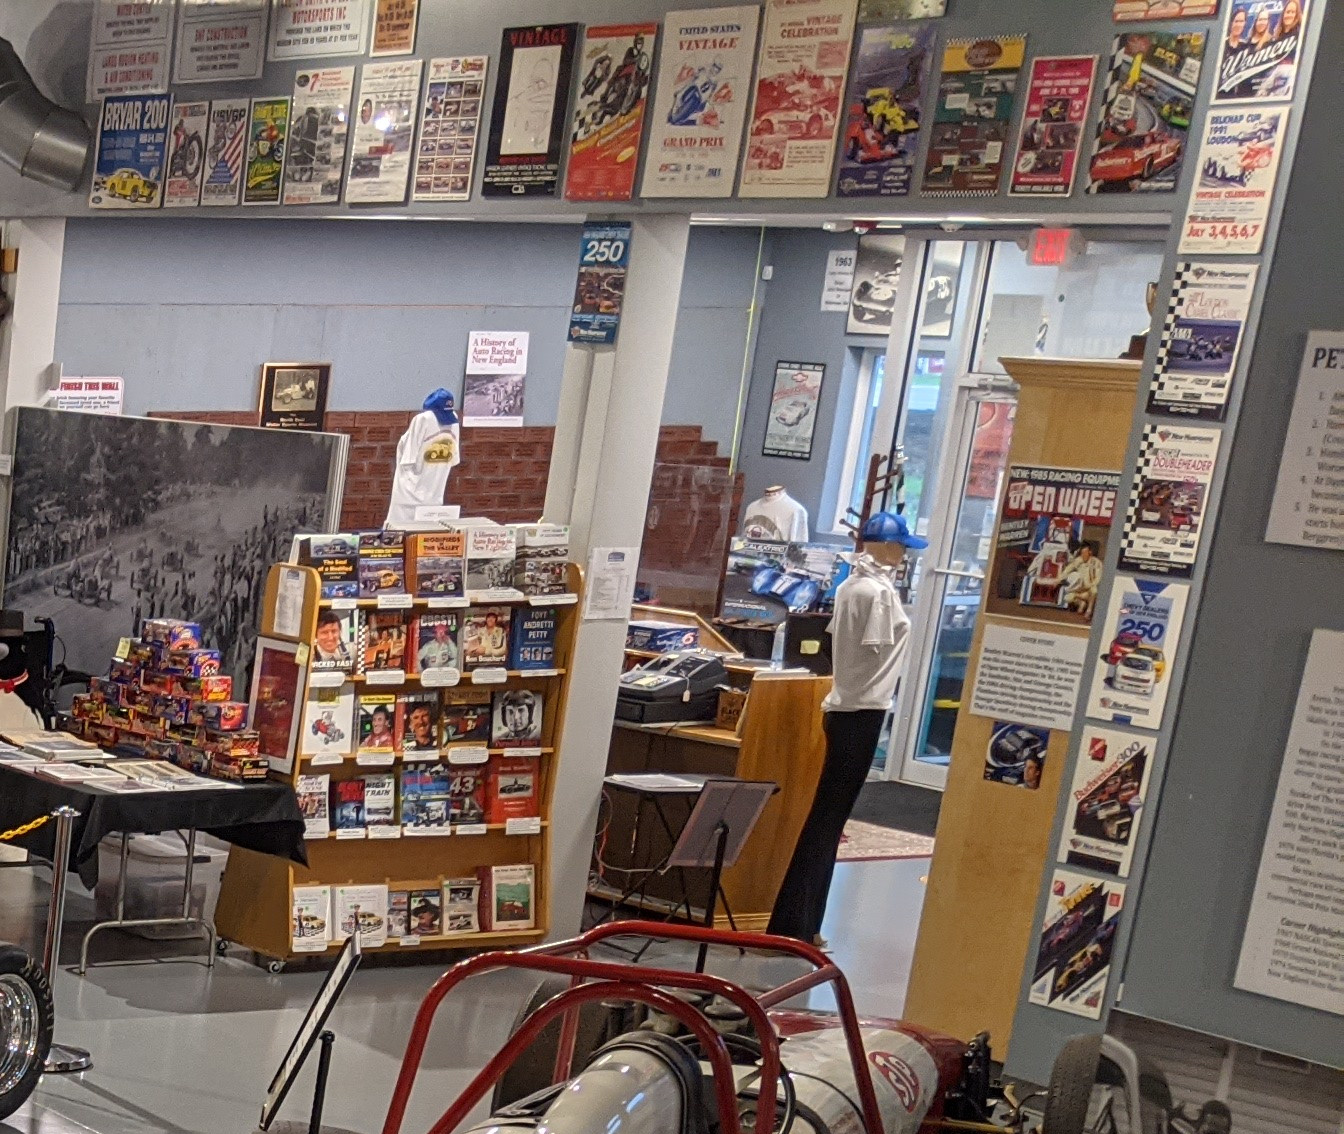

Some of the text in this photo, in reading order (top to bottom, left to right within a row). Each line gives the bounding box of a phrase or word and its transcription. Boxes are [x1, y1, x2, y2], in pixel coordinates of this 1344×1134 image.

[679, 38, 740, 50] VINTAGE
[1221, 35, 1296, 80] Women
[104, 102, 142, 131] BRYAR
[664, 136, 725, 148] GRAND PRIX
[584, 241, 623, 262] 250
[481, 338, 506, 347] History
[508, 338, 516, 346] of
[473, 347, 489, 355] Auto
[491, 348, 514, 357] Racing
[489, 356, 517, 366] England
[1153, 458, 1212, 472] DOUBLEHEADER
[1030, 470, 1120, 486] 1985 RACING EQUIPME
[1058, 491, 1116, 518] WHEE
[523, 620, 554, 630] ANDRETTI
[1119, 618, 1164, 642] 250
[1116, 741, 1141, 764] 300
[450, 775, 475, 793] 43
[1073, 759, 1121, 799] Budweiser
